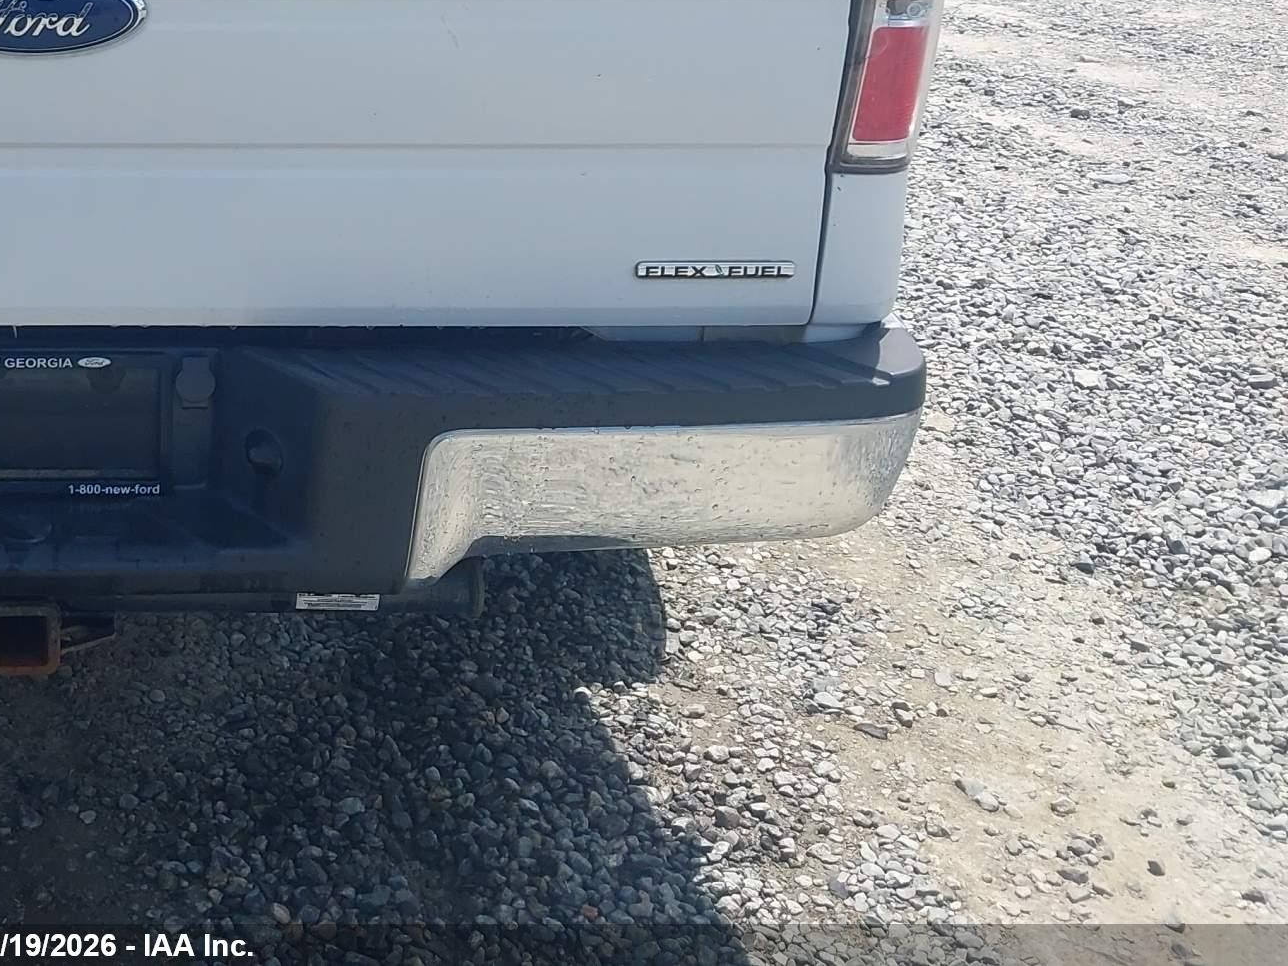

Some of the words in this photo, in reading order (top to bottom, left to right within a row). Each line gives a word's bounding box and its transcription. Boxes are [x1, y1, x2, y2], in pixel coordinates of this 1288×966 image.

[645, 265, 707, 278] FLEX
[728, 265, 787, 278] FUEL
[4, 357, 73, 369] GEORGIA
[68, 484, 160, 495] 1-800-new-ford
